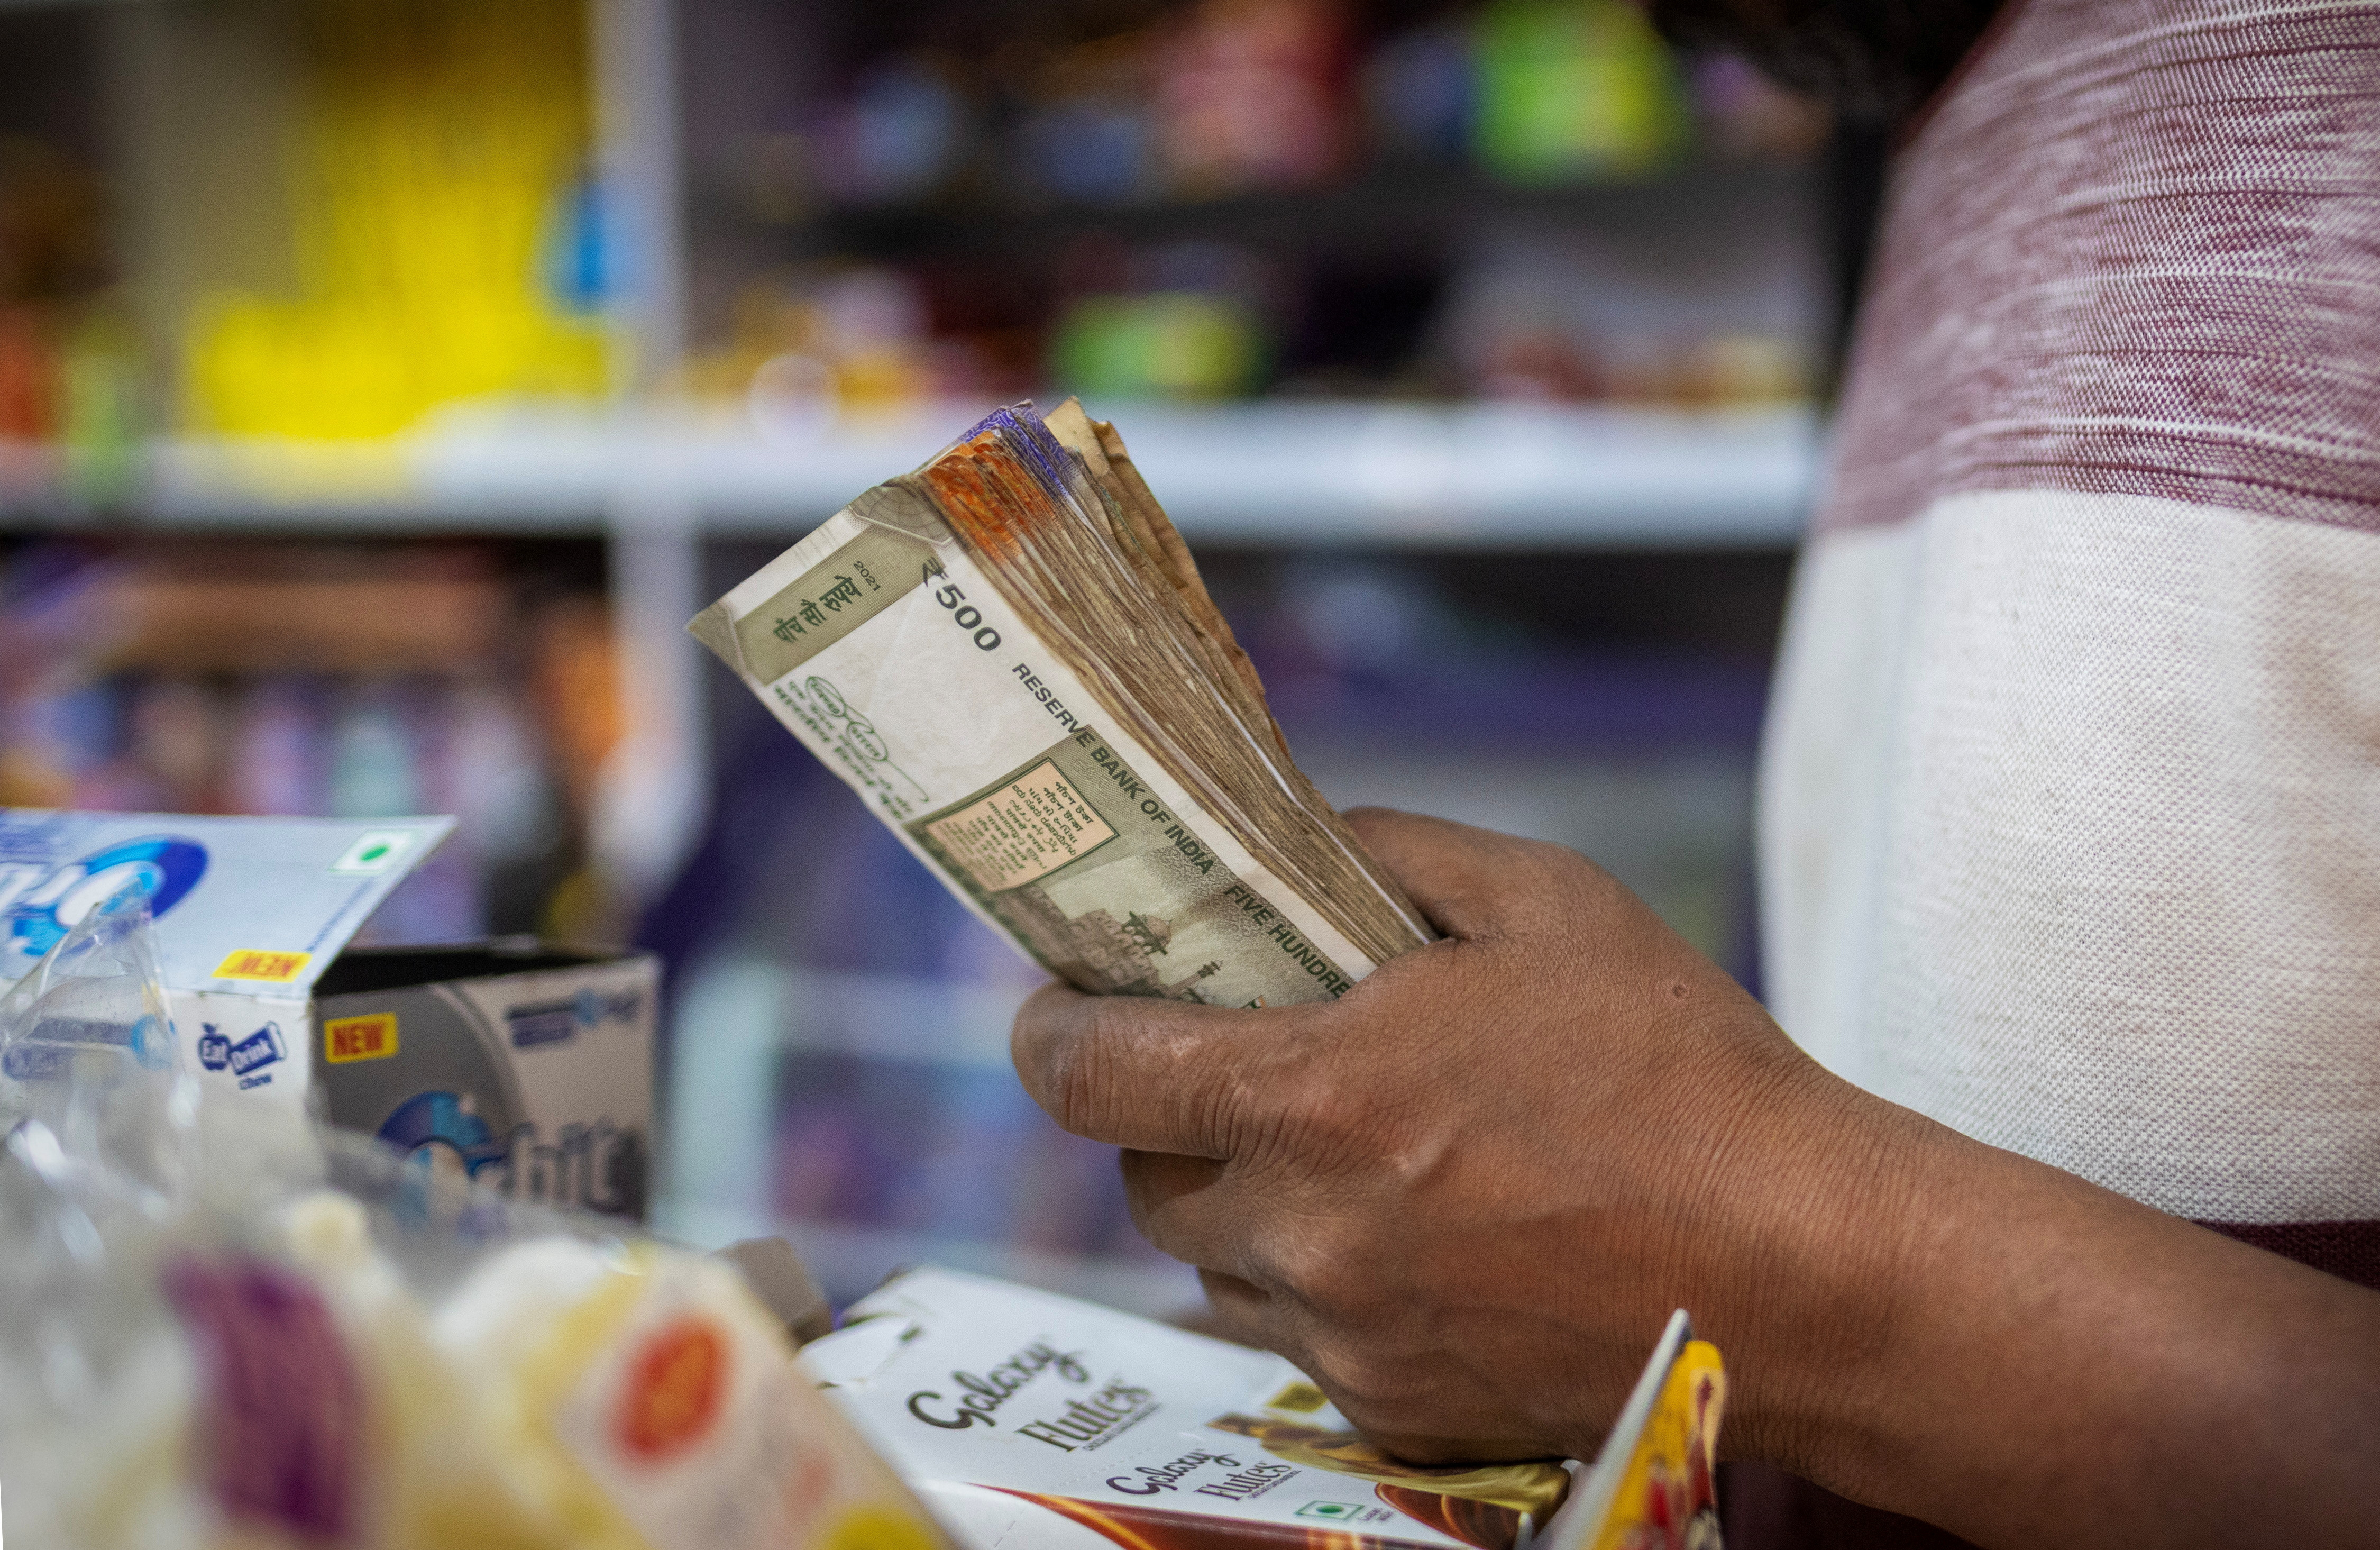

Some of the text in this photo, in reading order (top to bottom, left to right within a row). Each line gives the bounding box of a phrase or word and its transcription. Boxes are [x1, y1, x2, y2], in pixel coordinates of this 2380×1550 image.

[853, 561, 881, 591] 2021
[922, 557, 1001, 651] ₹500
[1012, 663, 1096, 747] RESERVE
[1090, 746, 1145, 800] BANK
[1141, 799, 1171, 824] OF
[1164, 824, 1214, 875] INDIA
[1224, 886, 1275, 926] FIVE
[202, 1038, 273, 1070] Eat Drink
[333, 1022, 385, 1056] NEW
[906, 1342, 1091, 1429] Galaxy
[1106, 1452, 1241, 1495] Galaxy
